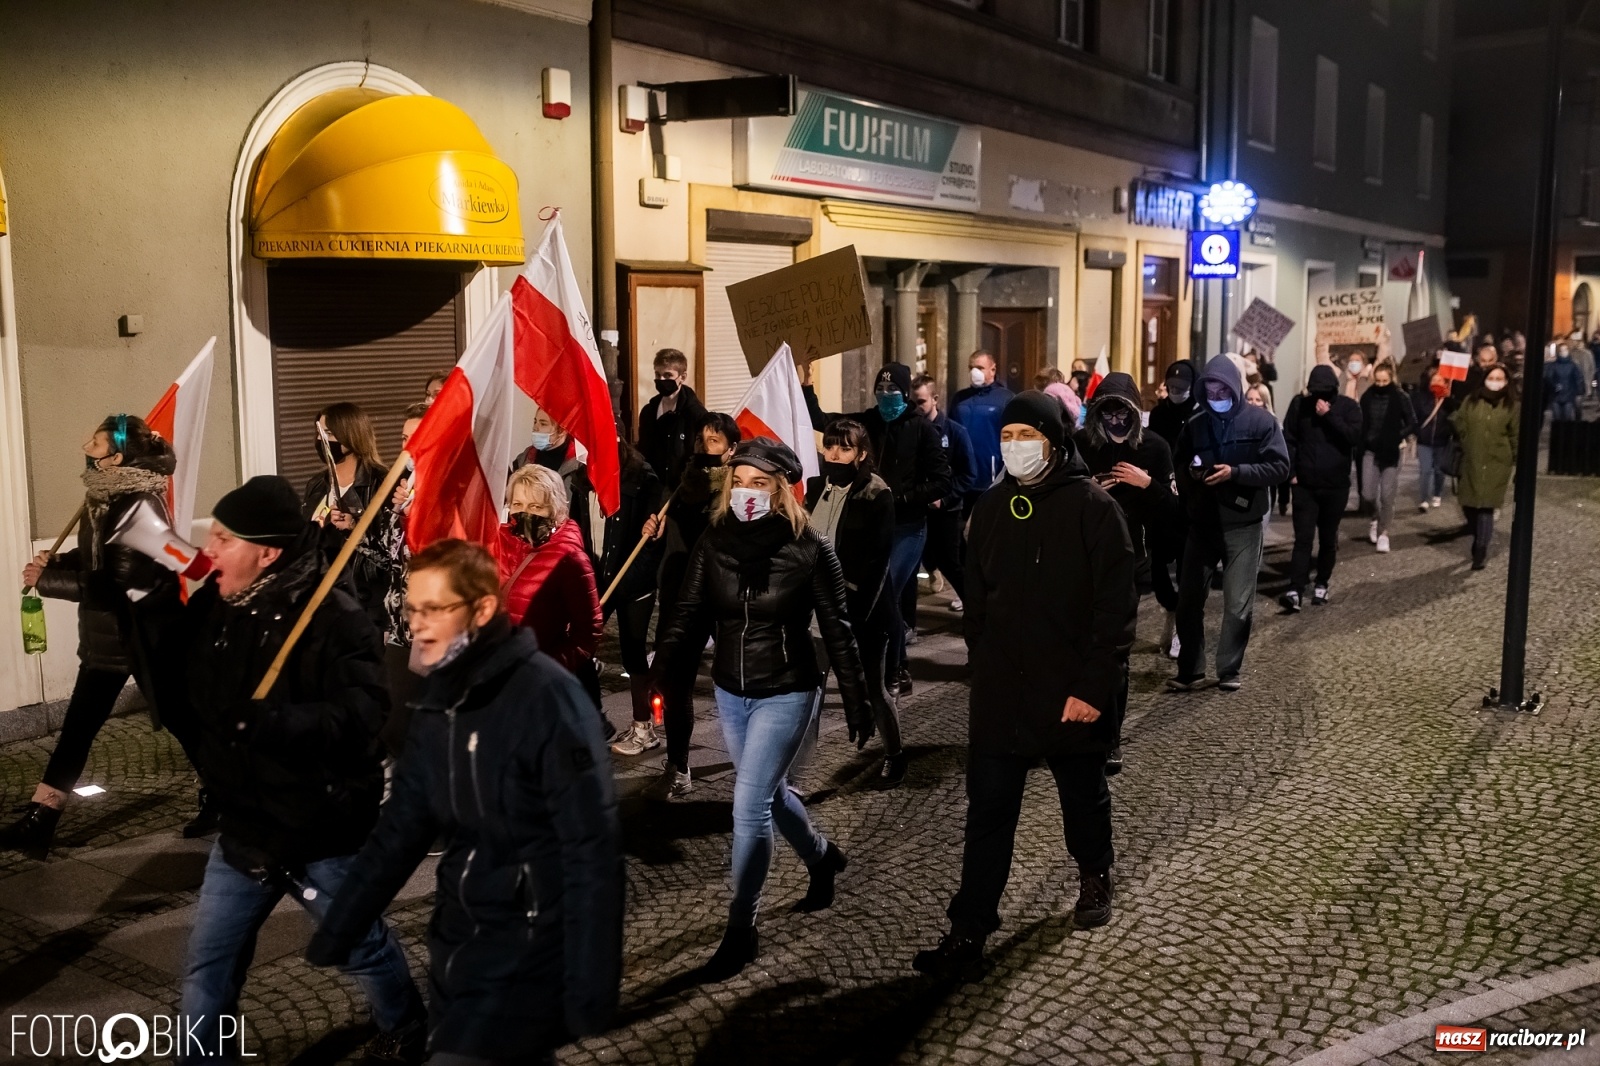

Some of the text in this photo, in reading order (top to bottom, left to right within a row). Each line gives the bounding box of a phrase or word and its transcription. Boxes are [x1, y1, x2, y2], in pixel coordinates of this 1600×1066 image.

[822, 107, 930, 164] FUJIFILM
[442, 191, 505, 214] Markiewka
[257, 240, 324, 253] PIEKARNIA
[328, 239, 410, 253] CUKIERNIA
[415, 241, 480, 255] PIEKARNIA
[481, 242, 521, 257] CUKIERNIA
[741, 273, 860, 327] JESZCZE POLSKA
[815, 299, 844, 319] KIEDY
[1318, 290, 1380, 308] CHCESZ
